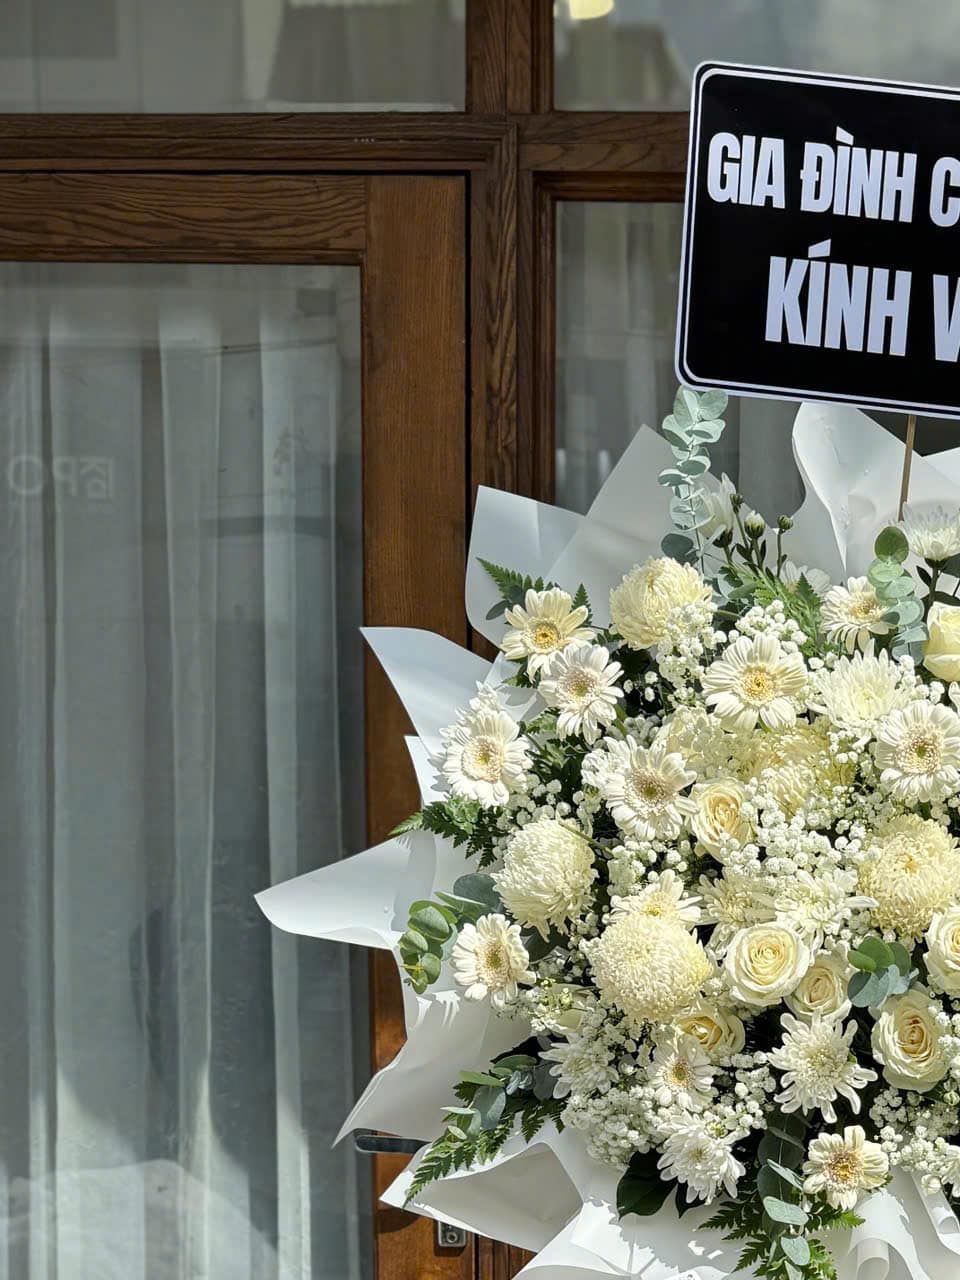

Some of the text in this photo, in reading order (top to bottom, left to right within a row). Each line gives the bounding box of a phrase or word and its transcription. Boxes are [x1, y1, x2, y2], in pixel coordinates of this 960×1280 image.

[707, 131, 785, 209] GIA
[800, 126, 918, 223] ĐÌNH
[764, 239, 912, 357] KÍNH
